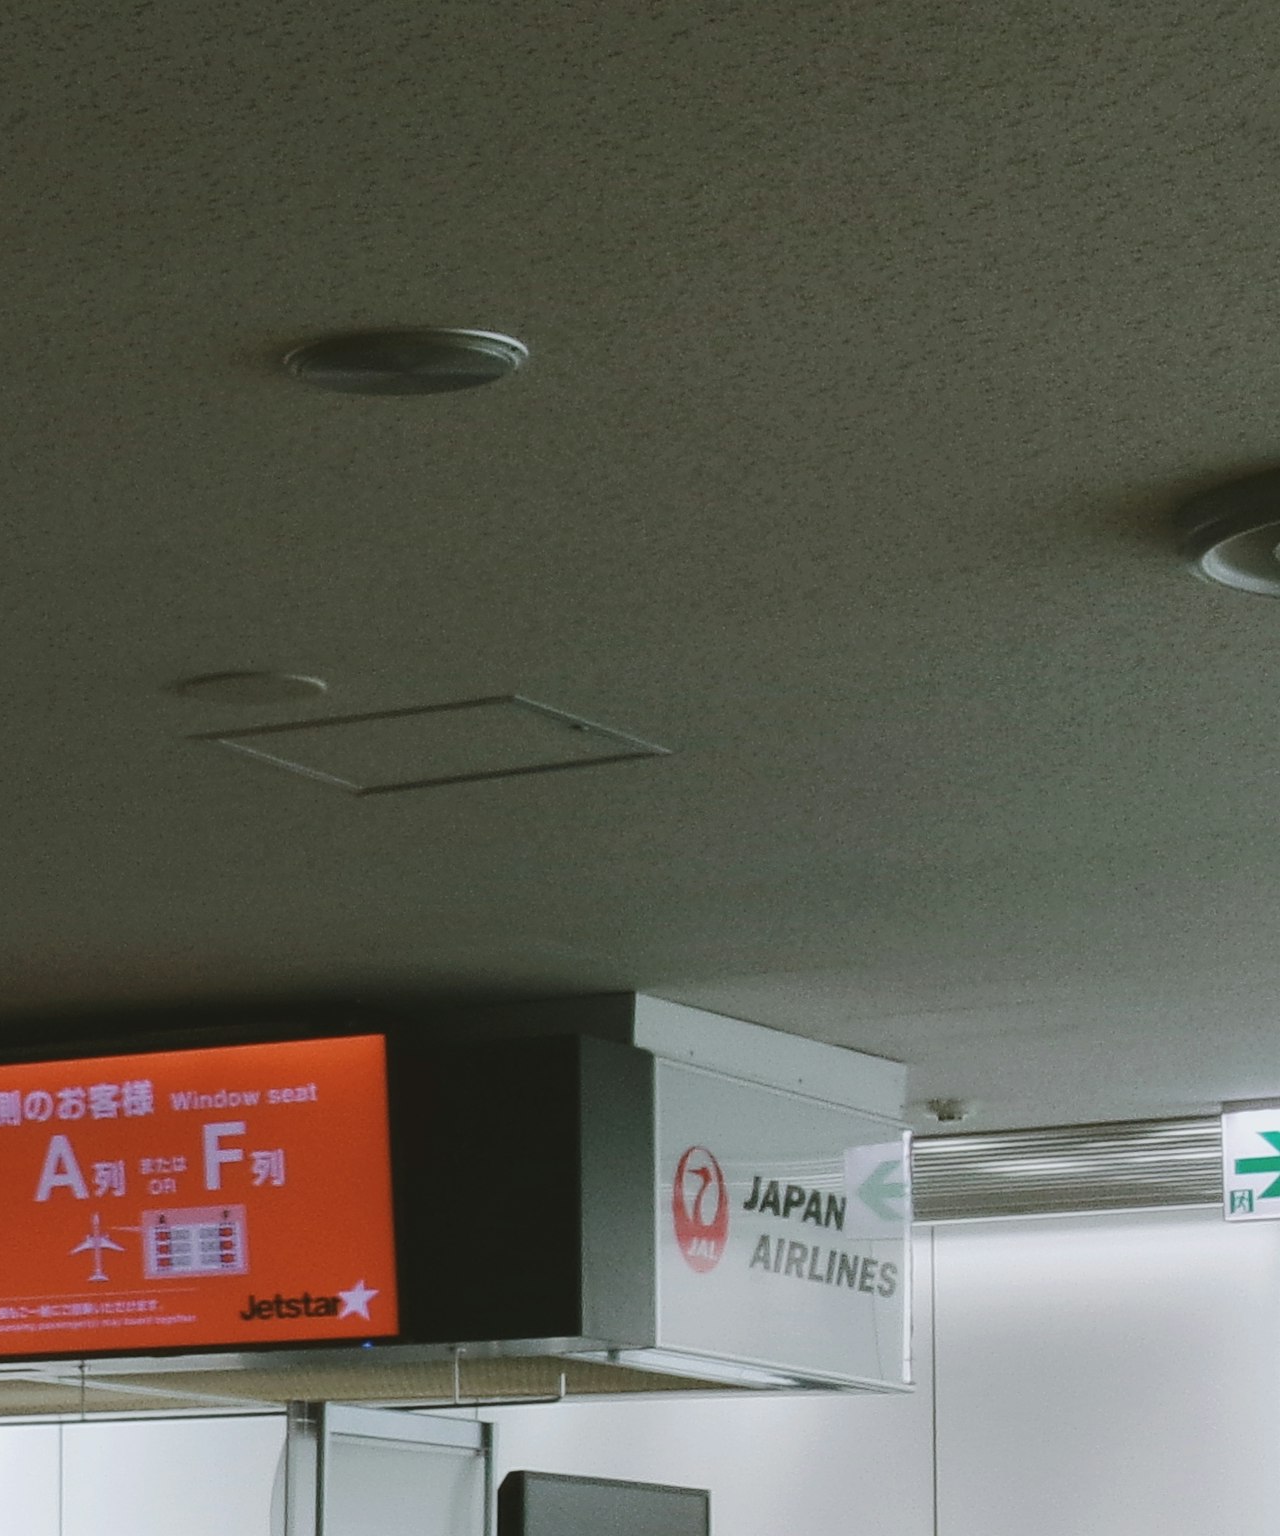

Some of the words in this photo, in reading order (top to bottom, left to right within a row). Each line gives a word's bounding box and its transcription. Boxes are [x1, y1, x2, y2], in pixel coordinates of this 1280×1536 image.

[169, 1088, 261, 1112] Window
[266, 1083, 319, 1105] seat
[138, 1156, 188, 1176] または
[148, 1178, 177, 1196] OR
[742, 1175, 848, 1232] JAPAN
[748, 1233, 899, 1299] AIRLINES
[238, 1292, 342, 1323] Jetstar
